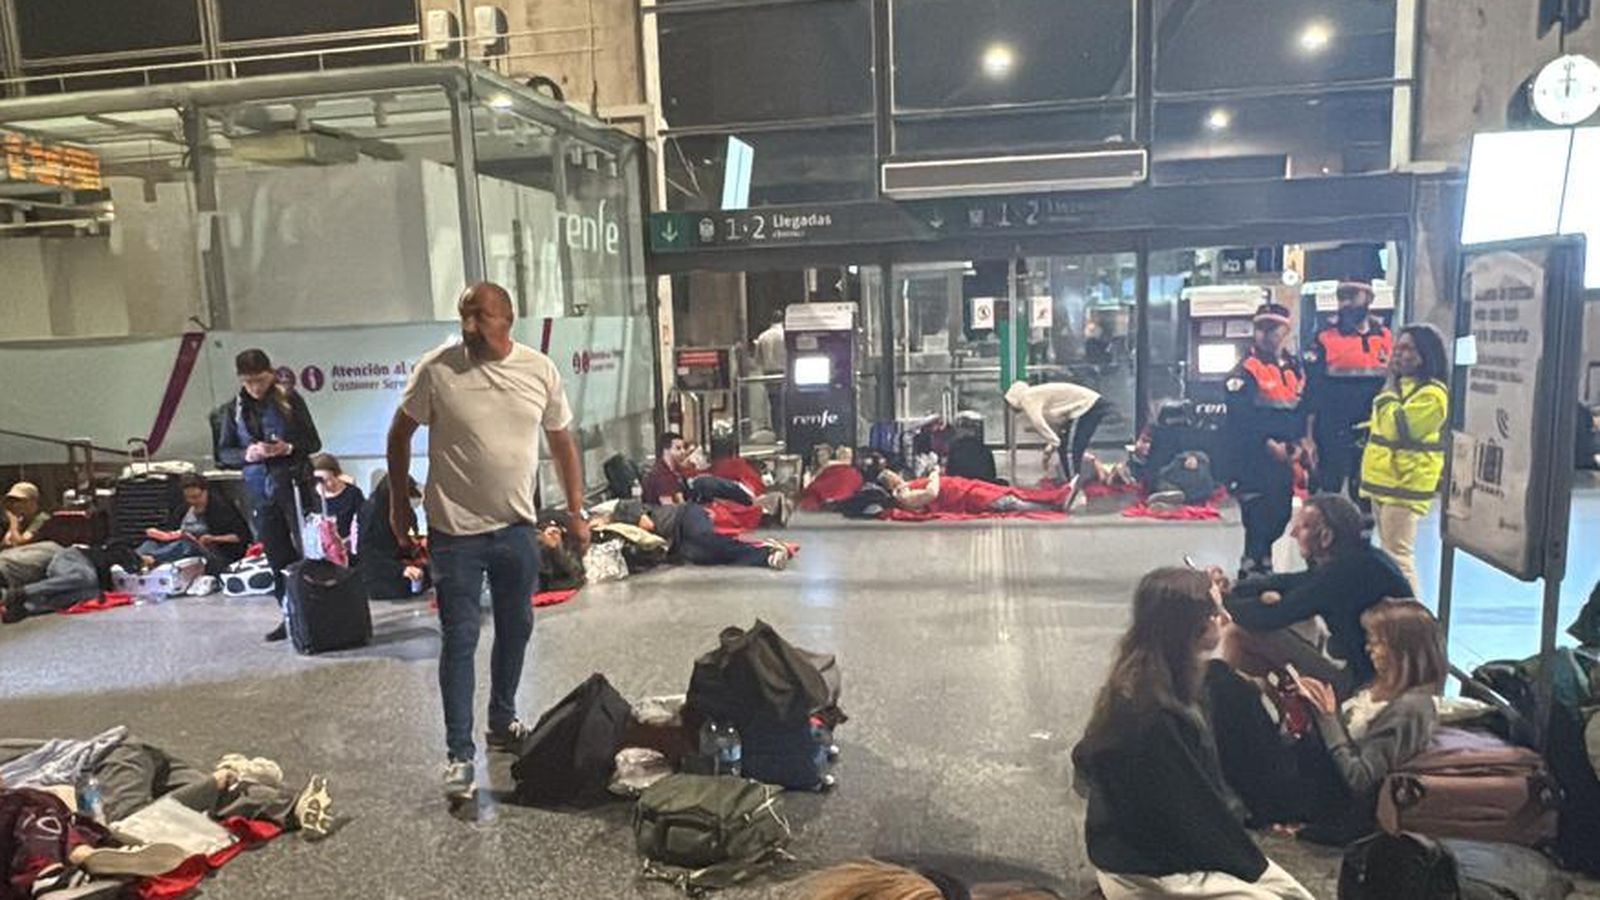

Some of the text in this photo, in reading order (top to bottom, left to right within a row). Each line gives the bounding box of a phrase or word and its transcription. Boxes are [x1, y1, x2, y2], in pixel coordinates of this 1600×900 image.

[555, 199, 619, 256] renfe
[773, 212, 832, 235] Llegadas
[332, 363, 390, 378] Atención
[394, 361, 406, 375] al
[793, 409, 839, 428] renfe
